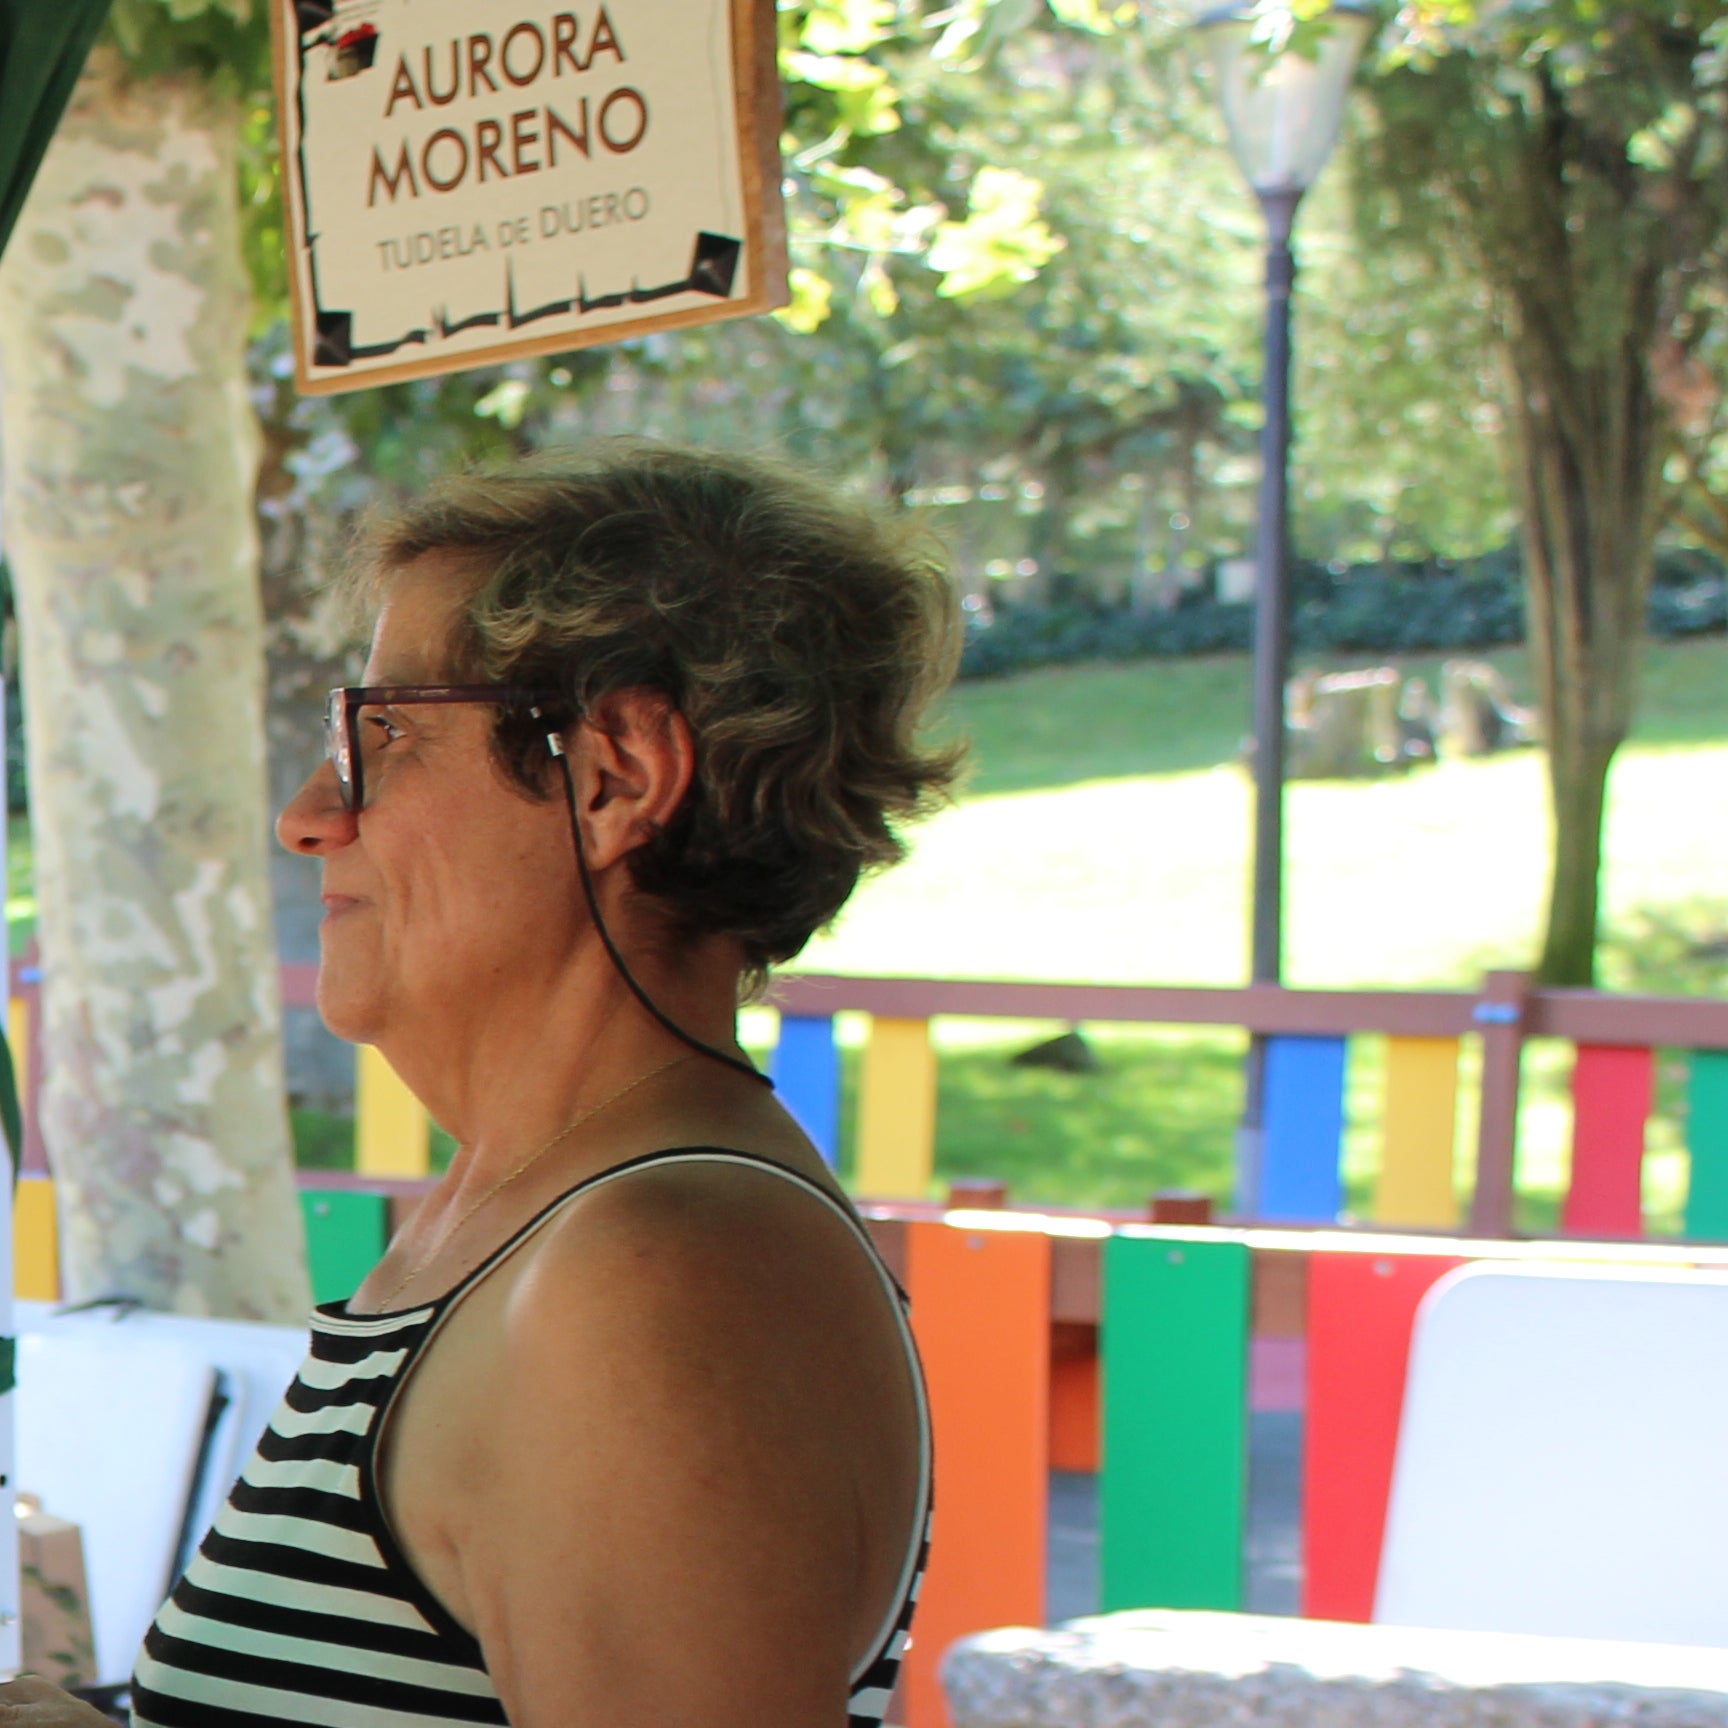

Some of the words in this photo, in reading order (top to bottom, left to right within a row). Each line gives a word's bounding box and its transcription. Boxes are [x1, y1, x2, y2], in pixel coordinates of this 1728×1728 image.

[384, 4, 626, 117] AURORA
[367, 86, 649, 208] MORENO
[376, 223, 490, 272] TUDELA
[497, 217, 530, 249] DE
[540, 186, 650, 240] DUERO
